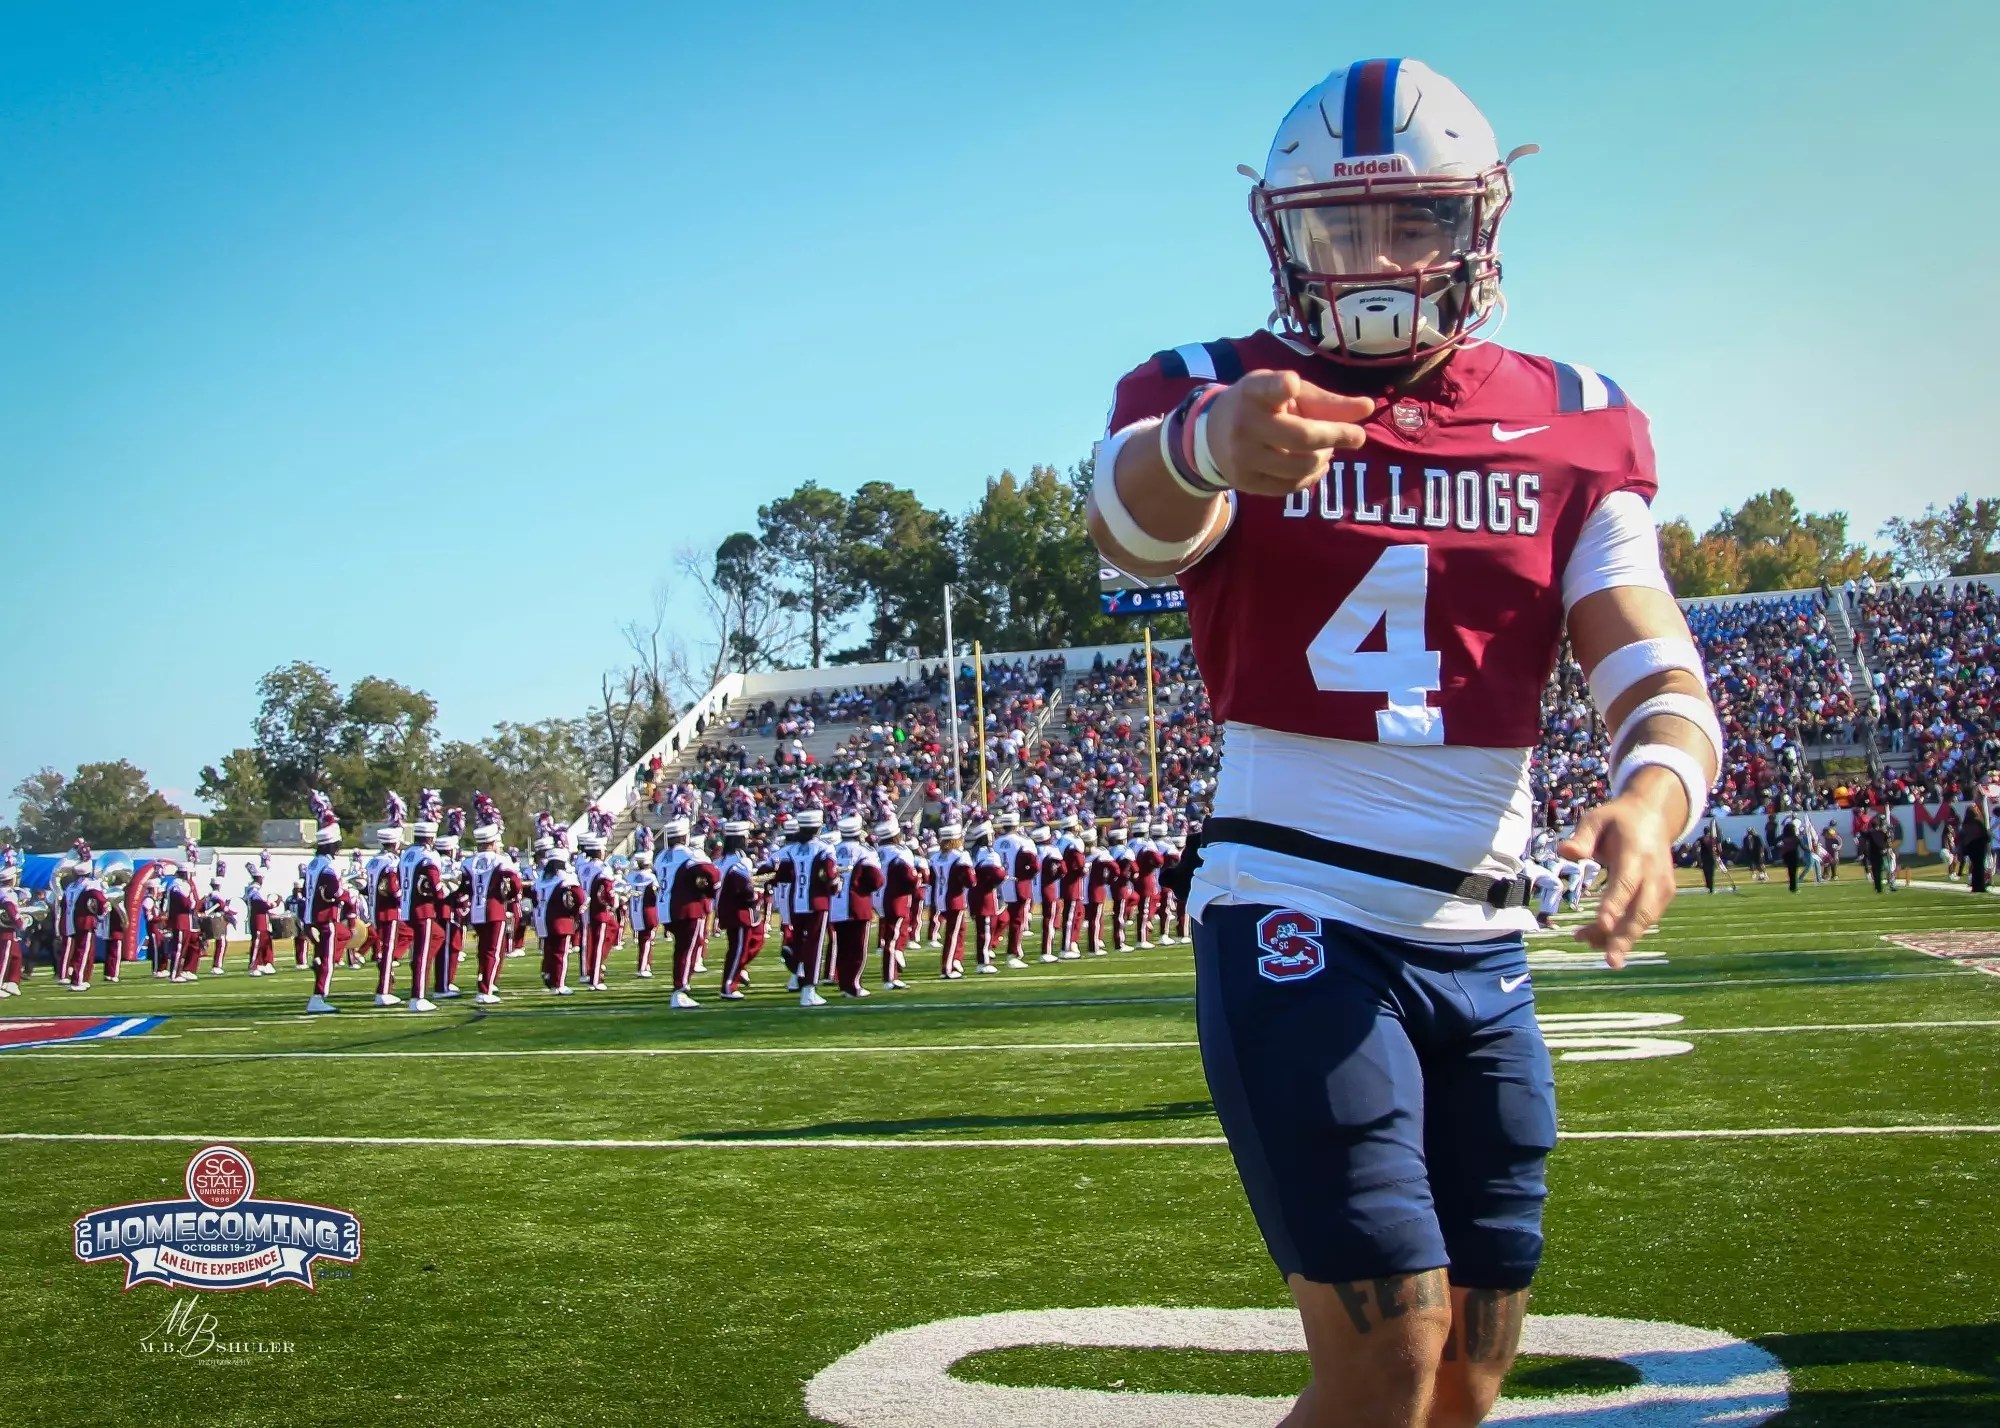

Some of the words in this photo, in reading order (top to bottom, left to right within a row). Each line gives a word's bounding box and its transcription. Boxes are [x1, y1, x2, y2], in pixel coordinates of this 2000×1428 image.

[1334, 159, 1403, 177] Riddell
[1133, 593, 1142, 606] 0
[1306, 544, 1445, 746] 4
